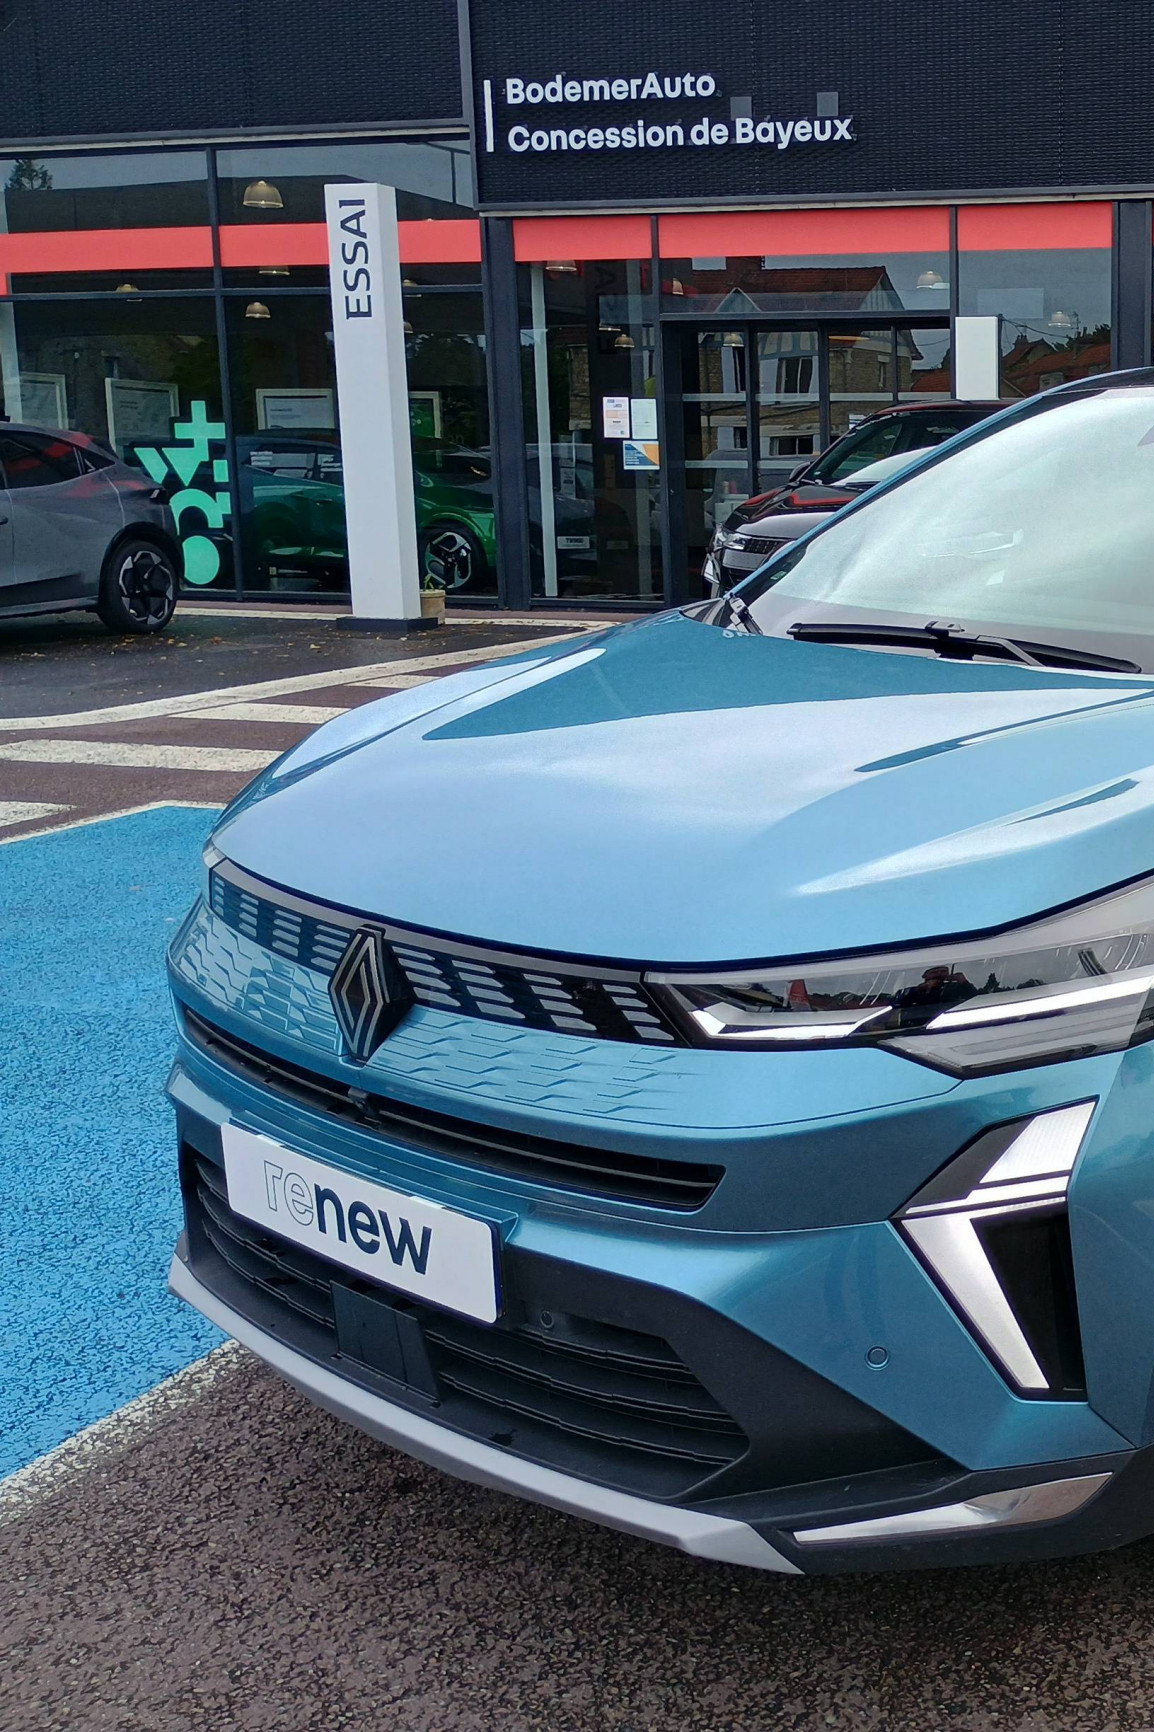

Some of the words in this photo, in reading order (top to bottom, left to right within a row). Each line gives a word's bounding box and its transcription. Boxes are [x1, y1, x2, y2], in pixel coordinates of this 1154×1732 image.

[506, 73, 715, 104] BodemerAuto
[508, 120, 684, 151] Concession
[690, 118, 729, 145] de
[735, 117, 852, 149] Bayeux
[339, 199, 372, 320] ESSAI
[264, 1160, 433, 1275] renew
